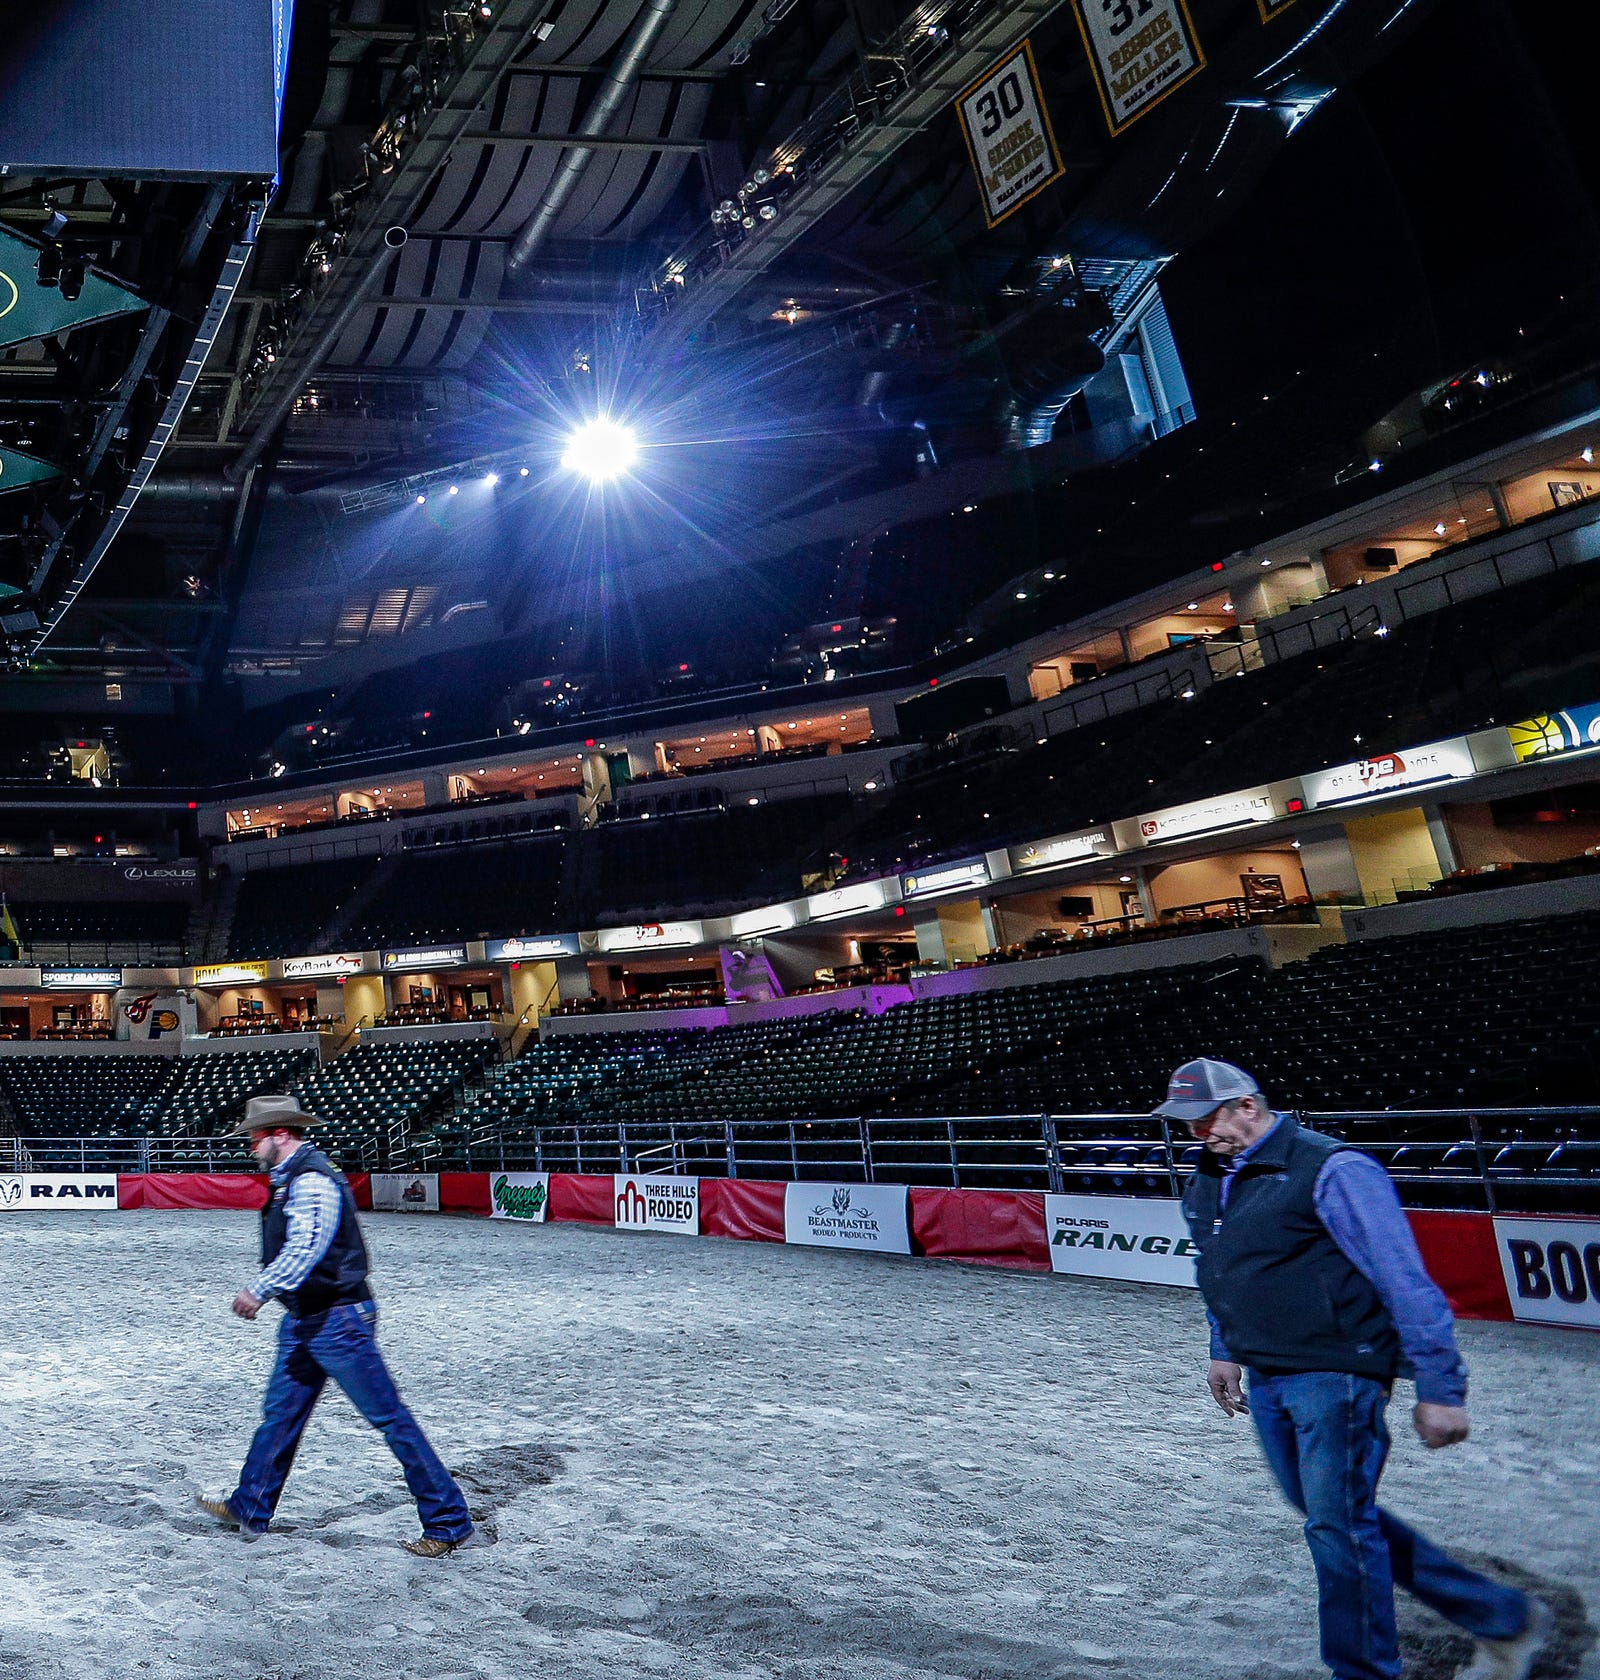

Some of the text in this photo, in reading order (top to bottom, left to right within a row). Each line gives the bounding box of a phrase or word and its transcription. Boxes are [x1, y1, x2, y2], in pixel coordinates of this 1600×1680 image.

[1108, 10, 1173, 75] REGGIE
[1110, 31, 1183, 100] MILLER
[1157, 59, 1182, 83] FAME
[976, 72, 1024, 138] 30
[987, 119, 1034, 169] GEORGE
[1357, 758, 1395, 779] the
[144, 869, 197, 878] LEXUS
[283, 959, 332, 974] KeyBank
[42, 973, 120, 982] SPORT GRAPHICS
[30, 1184, 115, 1198] RAM
[494, 1174, 546, 1211] Greene's
[645, 1184, 696, 1199] THREE HILLS
[649, 1199, 693, 1219] RODEO
[808, 1216, 880, 1232] BEASTMASTER
[1056, 1217, 1110, 1229] POLARIS
[812, 1228, 878, 1240] RODEO PRODUCTS
[1051, 1229, 1201, 1257] RANGE
